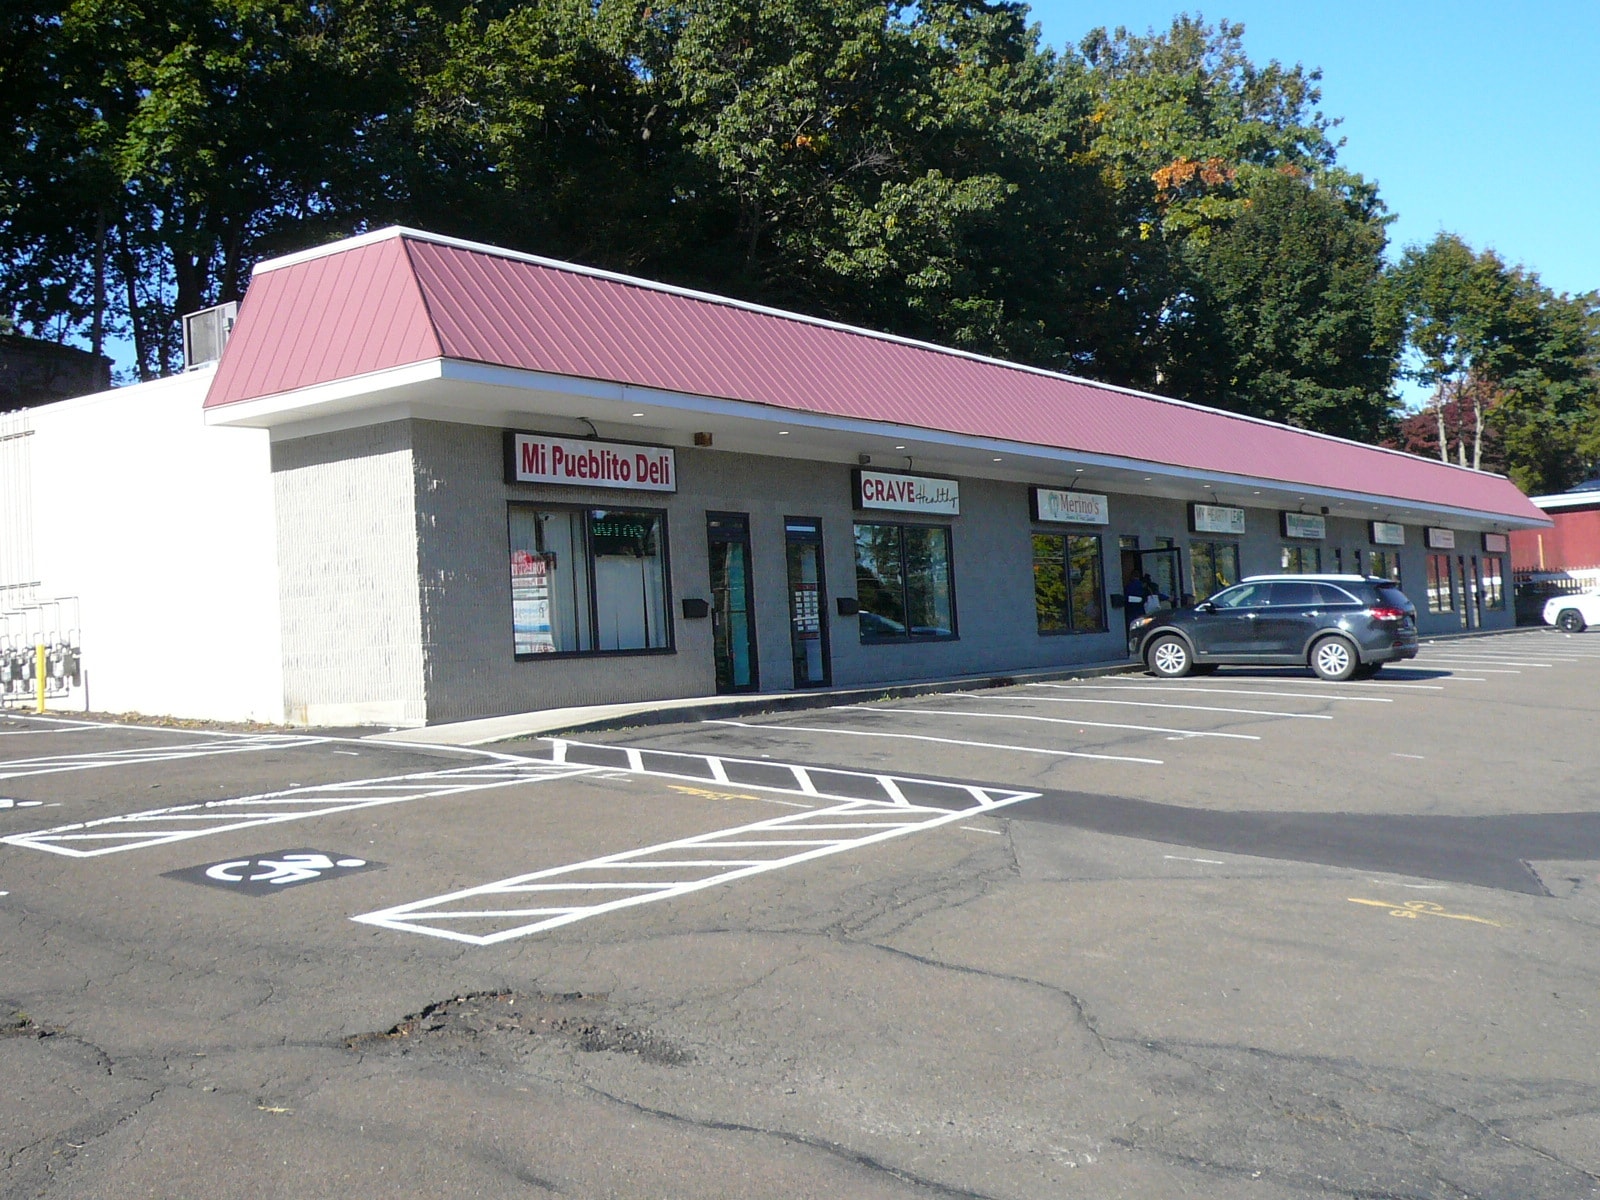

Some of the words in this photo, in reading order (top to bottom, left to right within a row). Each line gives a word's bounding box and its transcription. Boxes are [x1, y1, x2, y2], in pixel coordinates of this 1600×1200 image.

[522, 443, 546, 475] Mi
[552, 445, 631, 481] Pueblito
[635, 454, 670, 485] Deli
[863, 479, 915, 502] CRAVE
[1060, 493, 1099, 515] Merino's
